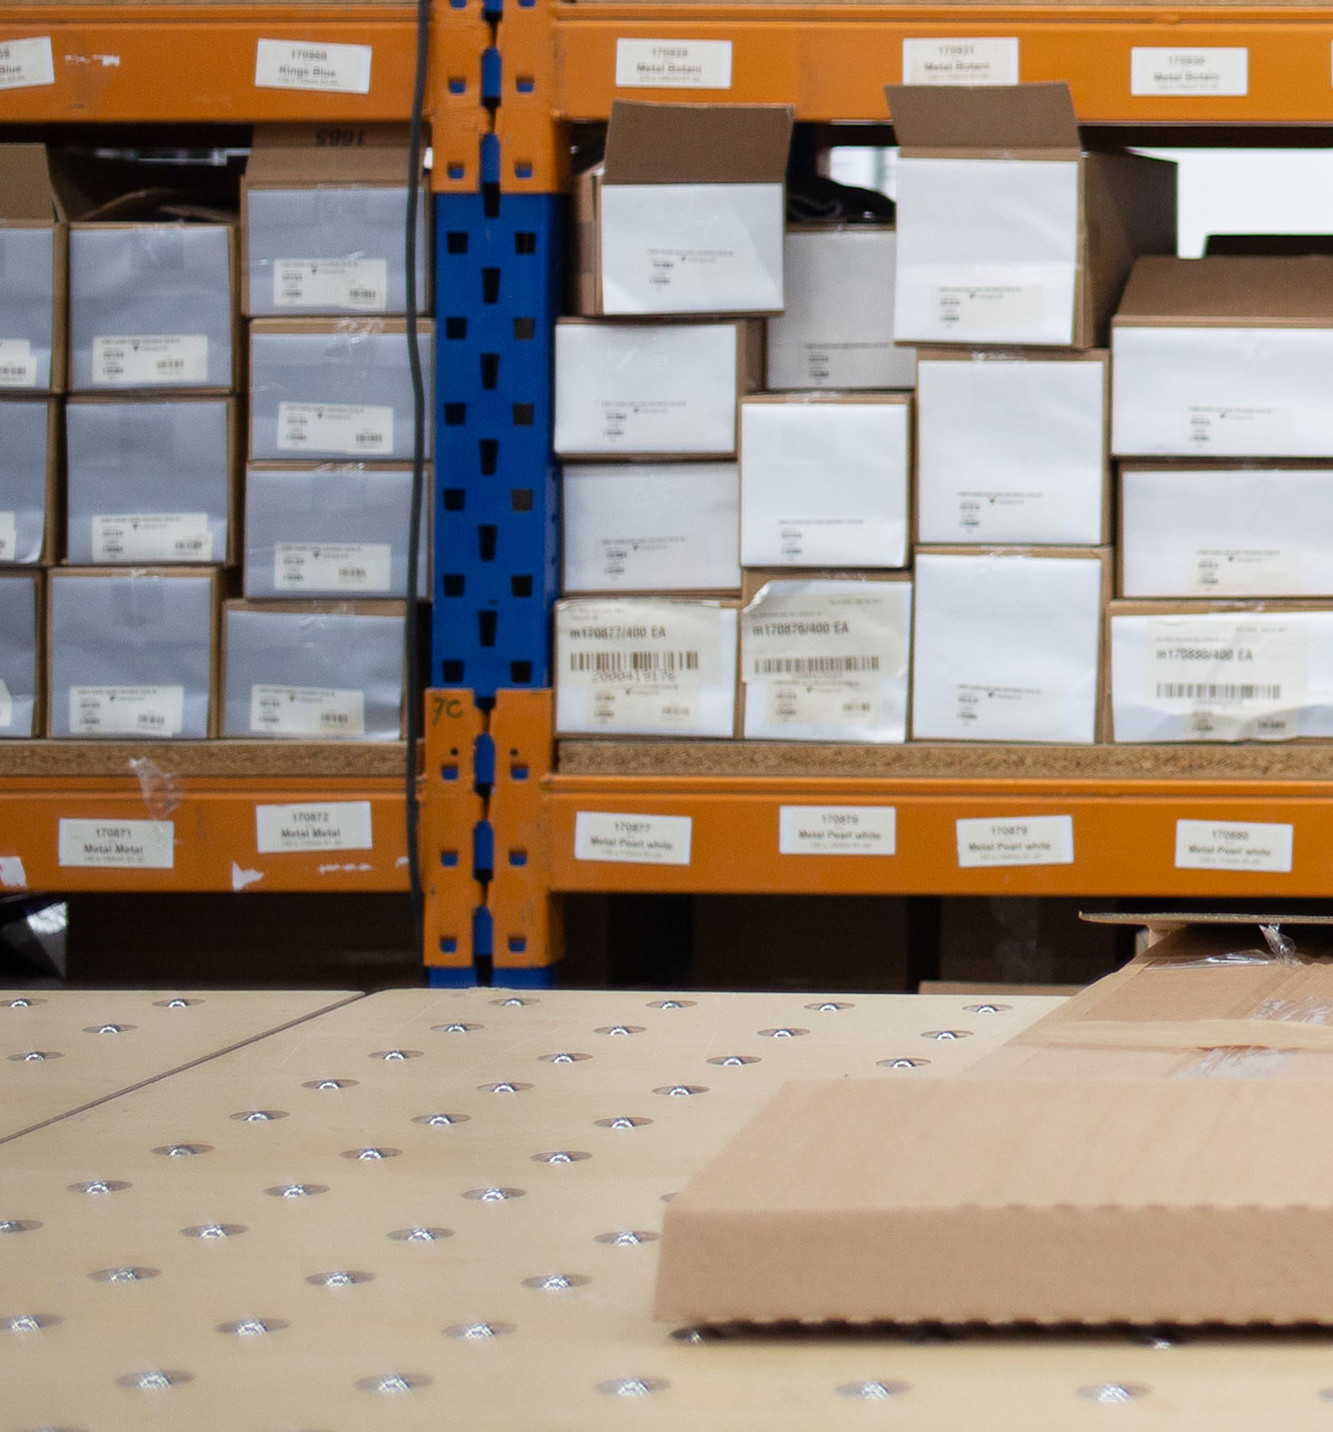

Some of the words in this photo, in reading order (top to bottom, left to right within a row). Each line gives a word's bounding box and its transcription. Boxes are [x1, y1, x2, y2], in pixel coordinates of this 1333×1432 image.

[312, 65, 337, 77] Blue
[636, 63, 665, 73] Metal
[924, 61, 953, 71] Metal
[1154, 73, 1182, 82] Metal
[651, 625, 666, 638] EA
[834, 620, 849, 635] EA
[1238, 647, 1253, 661] EA
[281, 828, 310, 839] Metal
[312, 827, 341, 839] Metal
[798, 829, 825, 840] Metal
[855, 830, 882, 841] white
[85, 843, 113, 854] Metal
[116, 843, 145, 855] Metal
[591, 836, 616, 847] Metal
[646, 840, 673, 851] white
[968, 841, 995, 852] Metal
[1025, 840, 1051, 851] white
[1188, 844, 1215, 855] Metal
[1245, 846, 1271, 858] white
